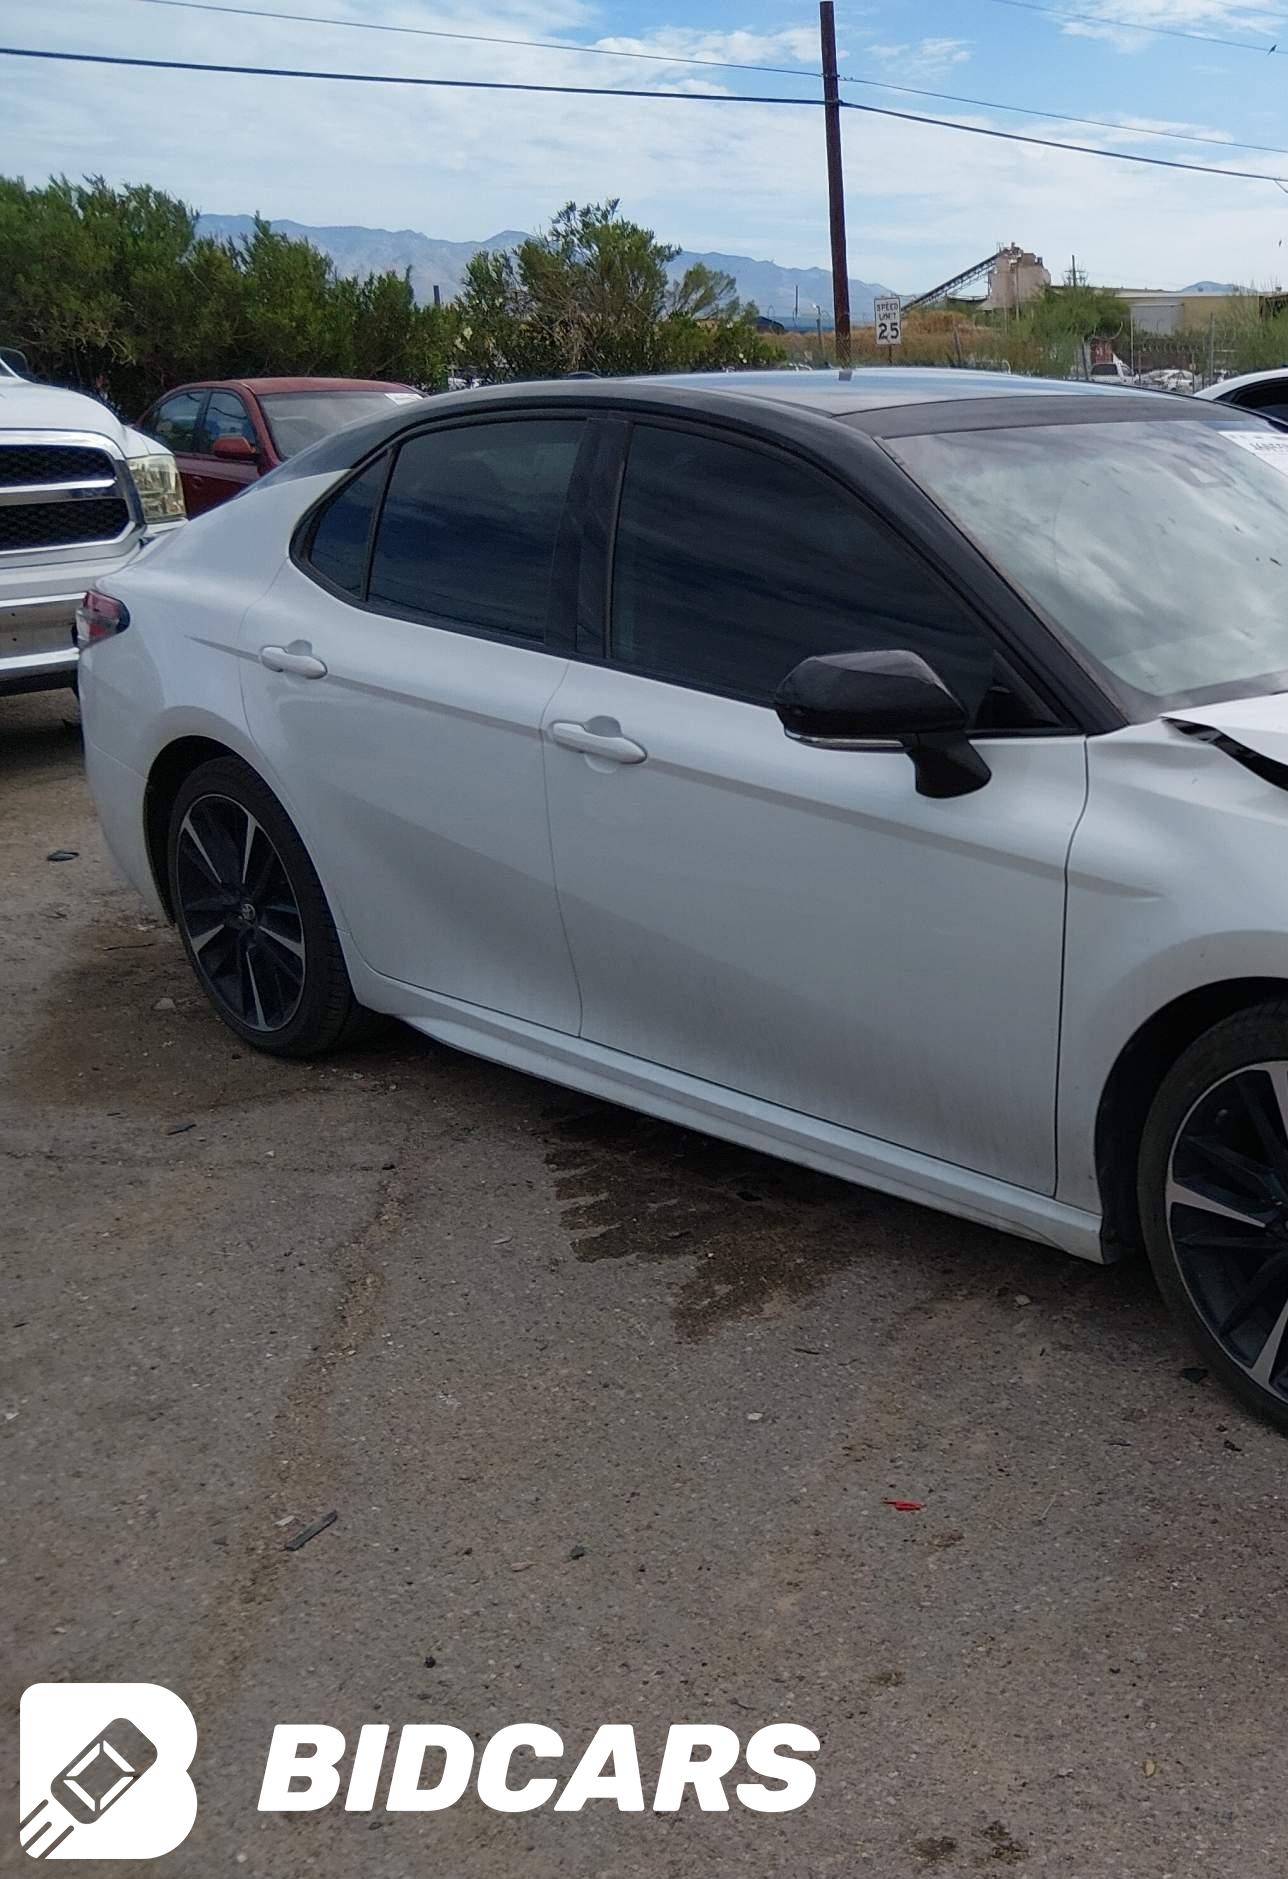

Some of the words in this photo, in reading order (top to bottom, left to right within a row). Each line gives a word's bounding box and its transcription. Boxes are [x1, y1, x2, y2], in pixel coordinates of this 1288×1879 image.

[876, 303, 898, 312] SPEED
[879, 312, 896, 321] LIMIT
[878, 322, 899, 340] 25
